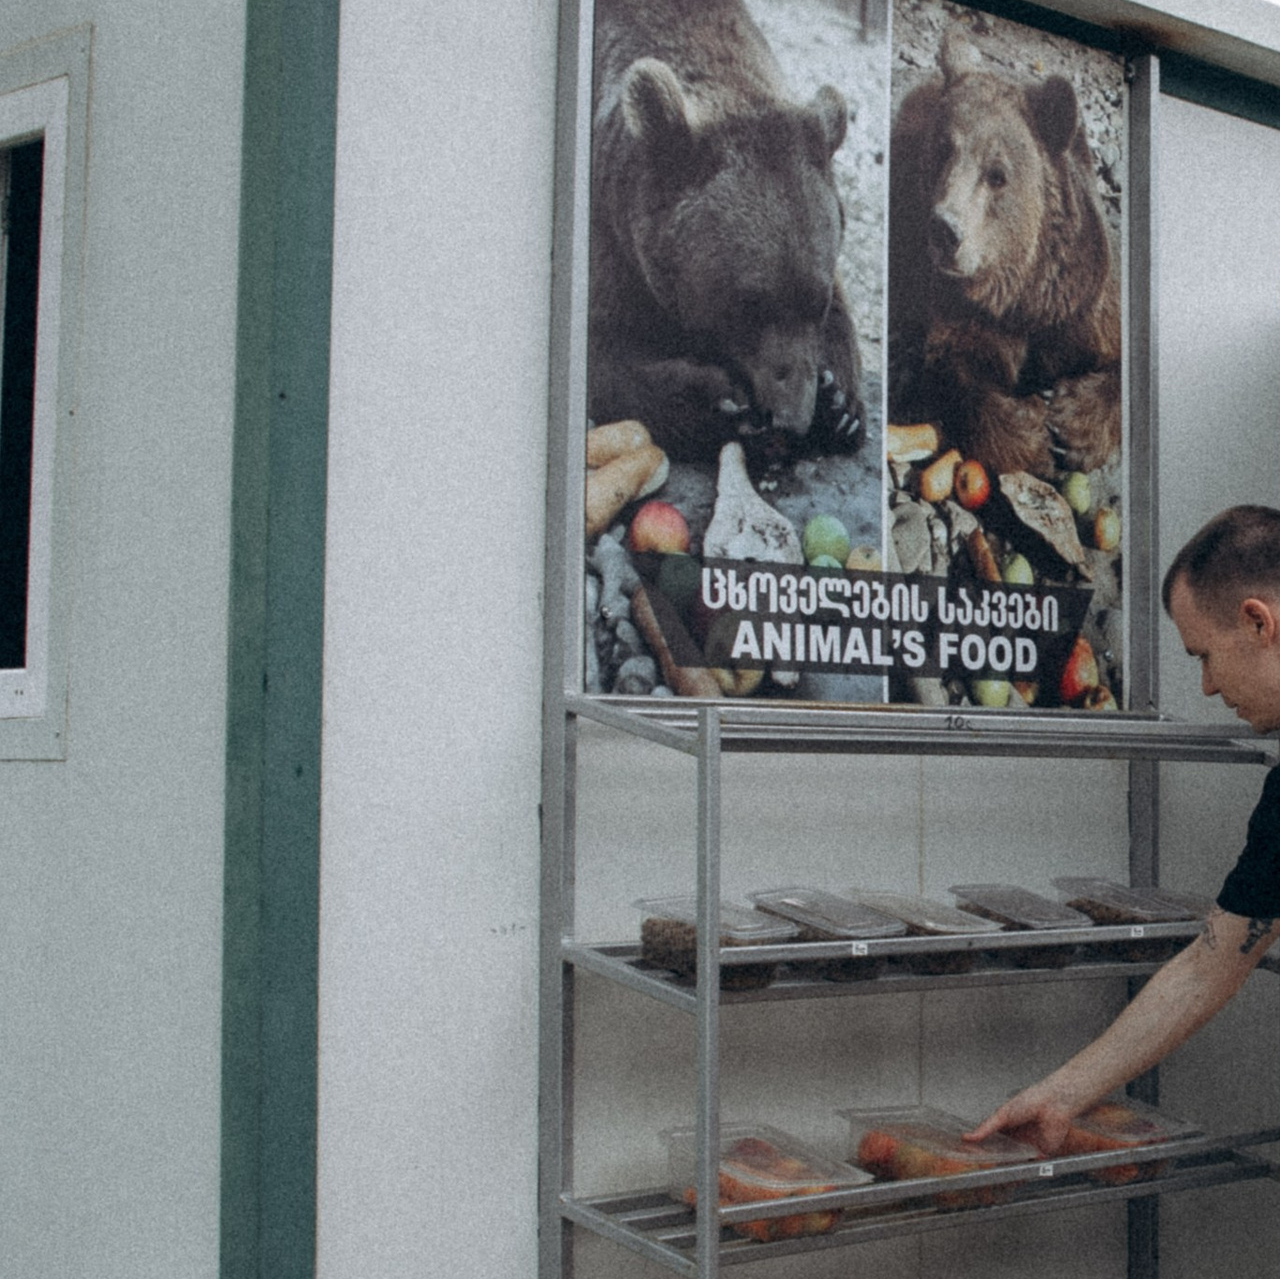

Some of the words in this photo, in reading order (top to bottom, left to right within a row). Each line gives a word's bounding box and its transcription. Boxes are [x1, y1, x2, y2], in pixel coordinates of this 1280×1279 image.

[702, 567, 928, 623] ცხოველების
[938, 586, 1059, 633] საკვები
[731, 621, 926, 668] ANIMAL'S
[939, 632, 1038, 672] FOOD
